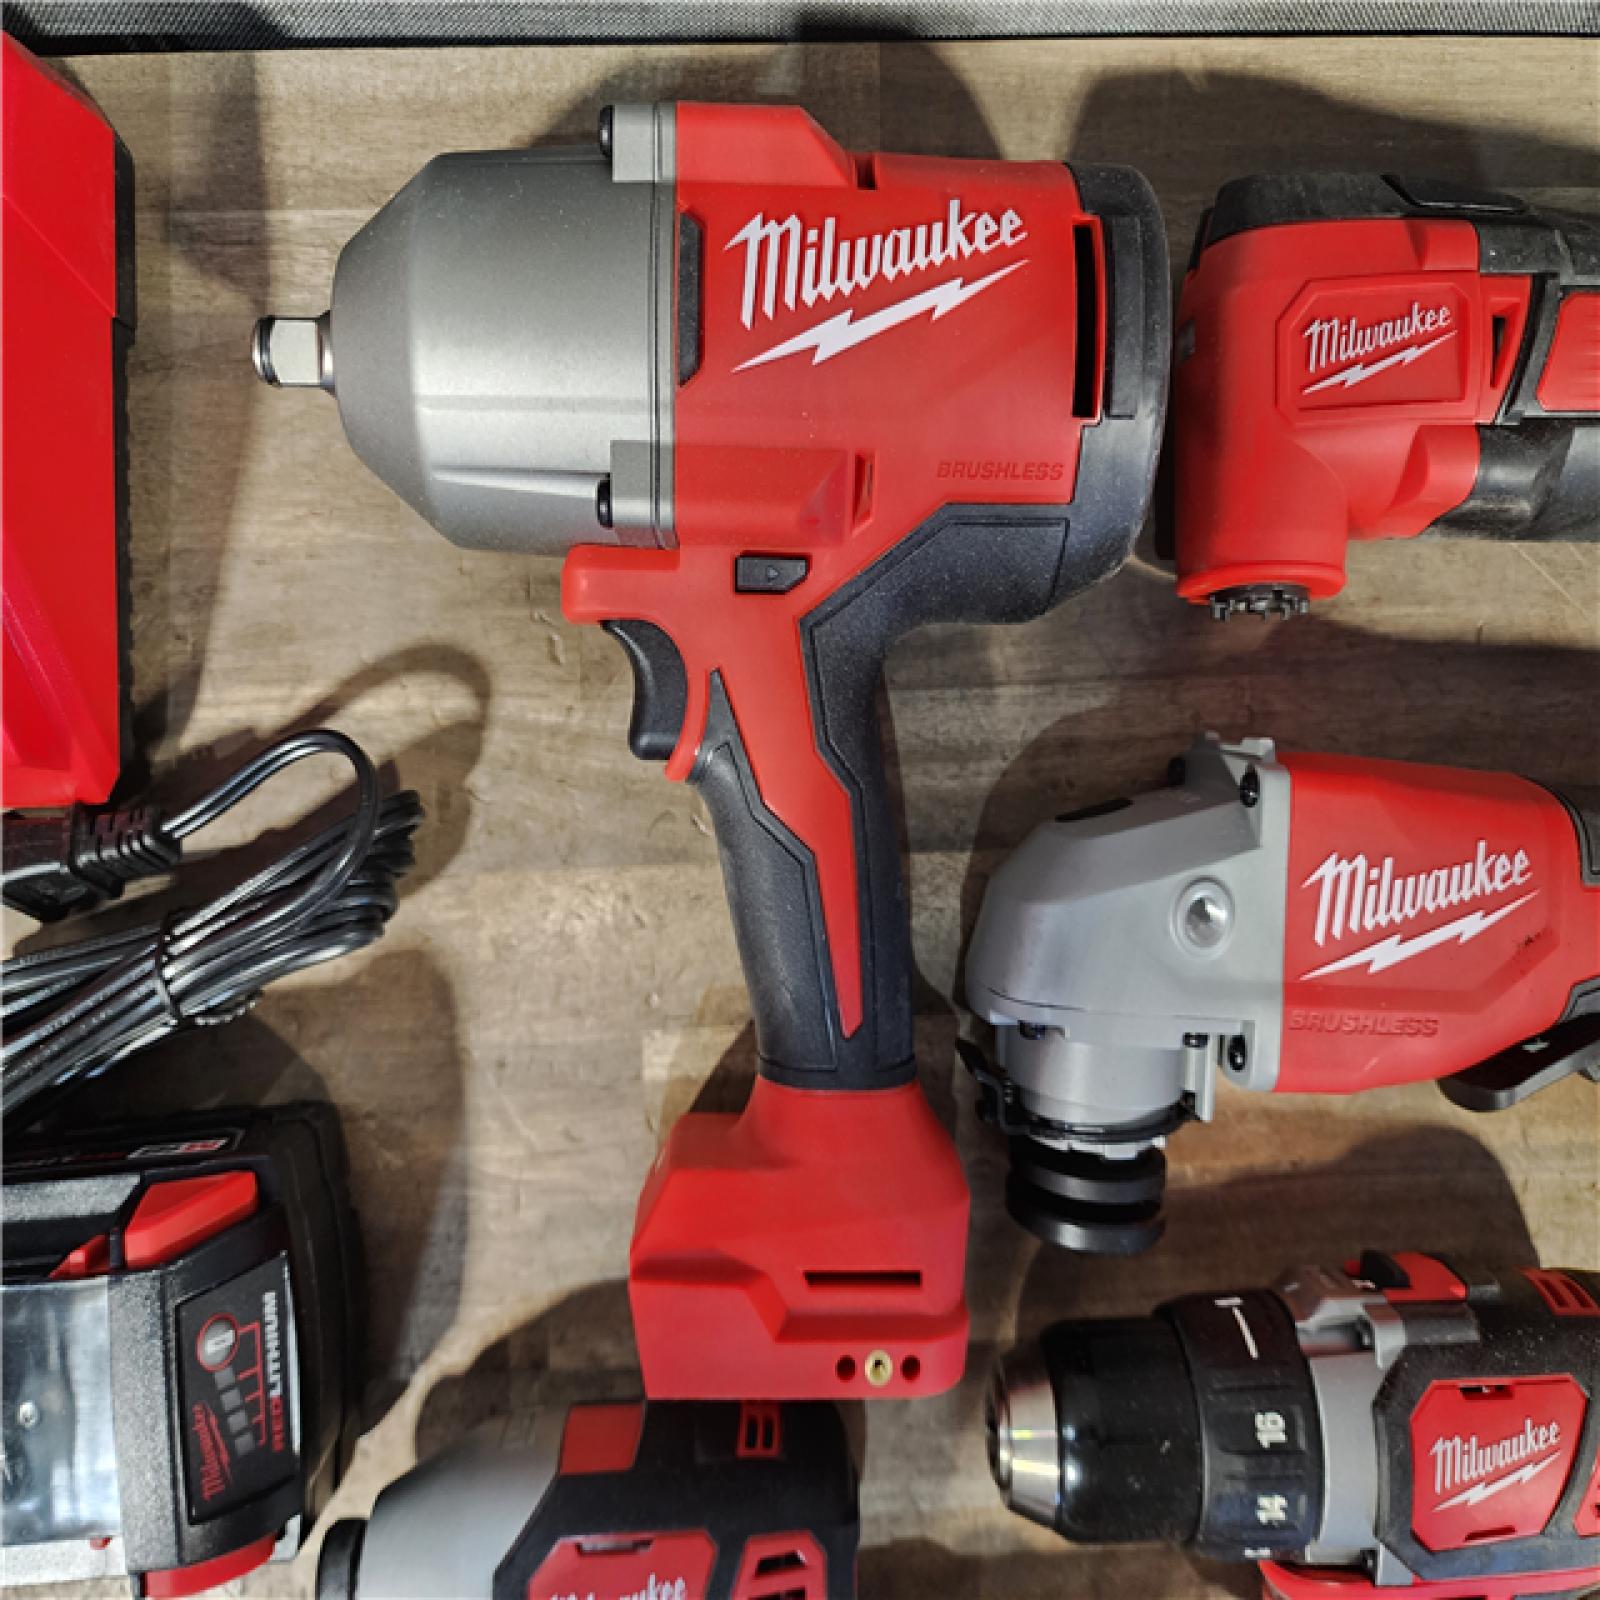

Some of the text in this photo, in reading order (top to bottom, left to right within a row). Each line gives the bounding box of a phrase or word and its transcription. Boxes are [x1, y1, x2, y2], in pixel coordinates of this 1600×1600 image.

[724, 199, 1028, 331] Milwaukee
[1303, 302, 1452, 373] Milwaukee
[937, 460, 1065, 480] BRUSHLESS
[1301, 840, 1533, 947] Milwaukee
[1288, 1010, 1440, 1038] BRUSHLESS
[1254, 1412, 1287, 1449] 16
[1429, 1417, 1561, 1495] Milwaukee
